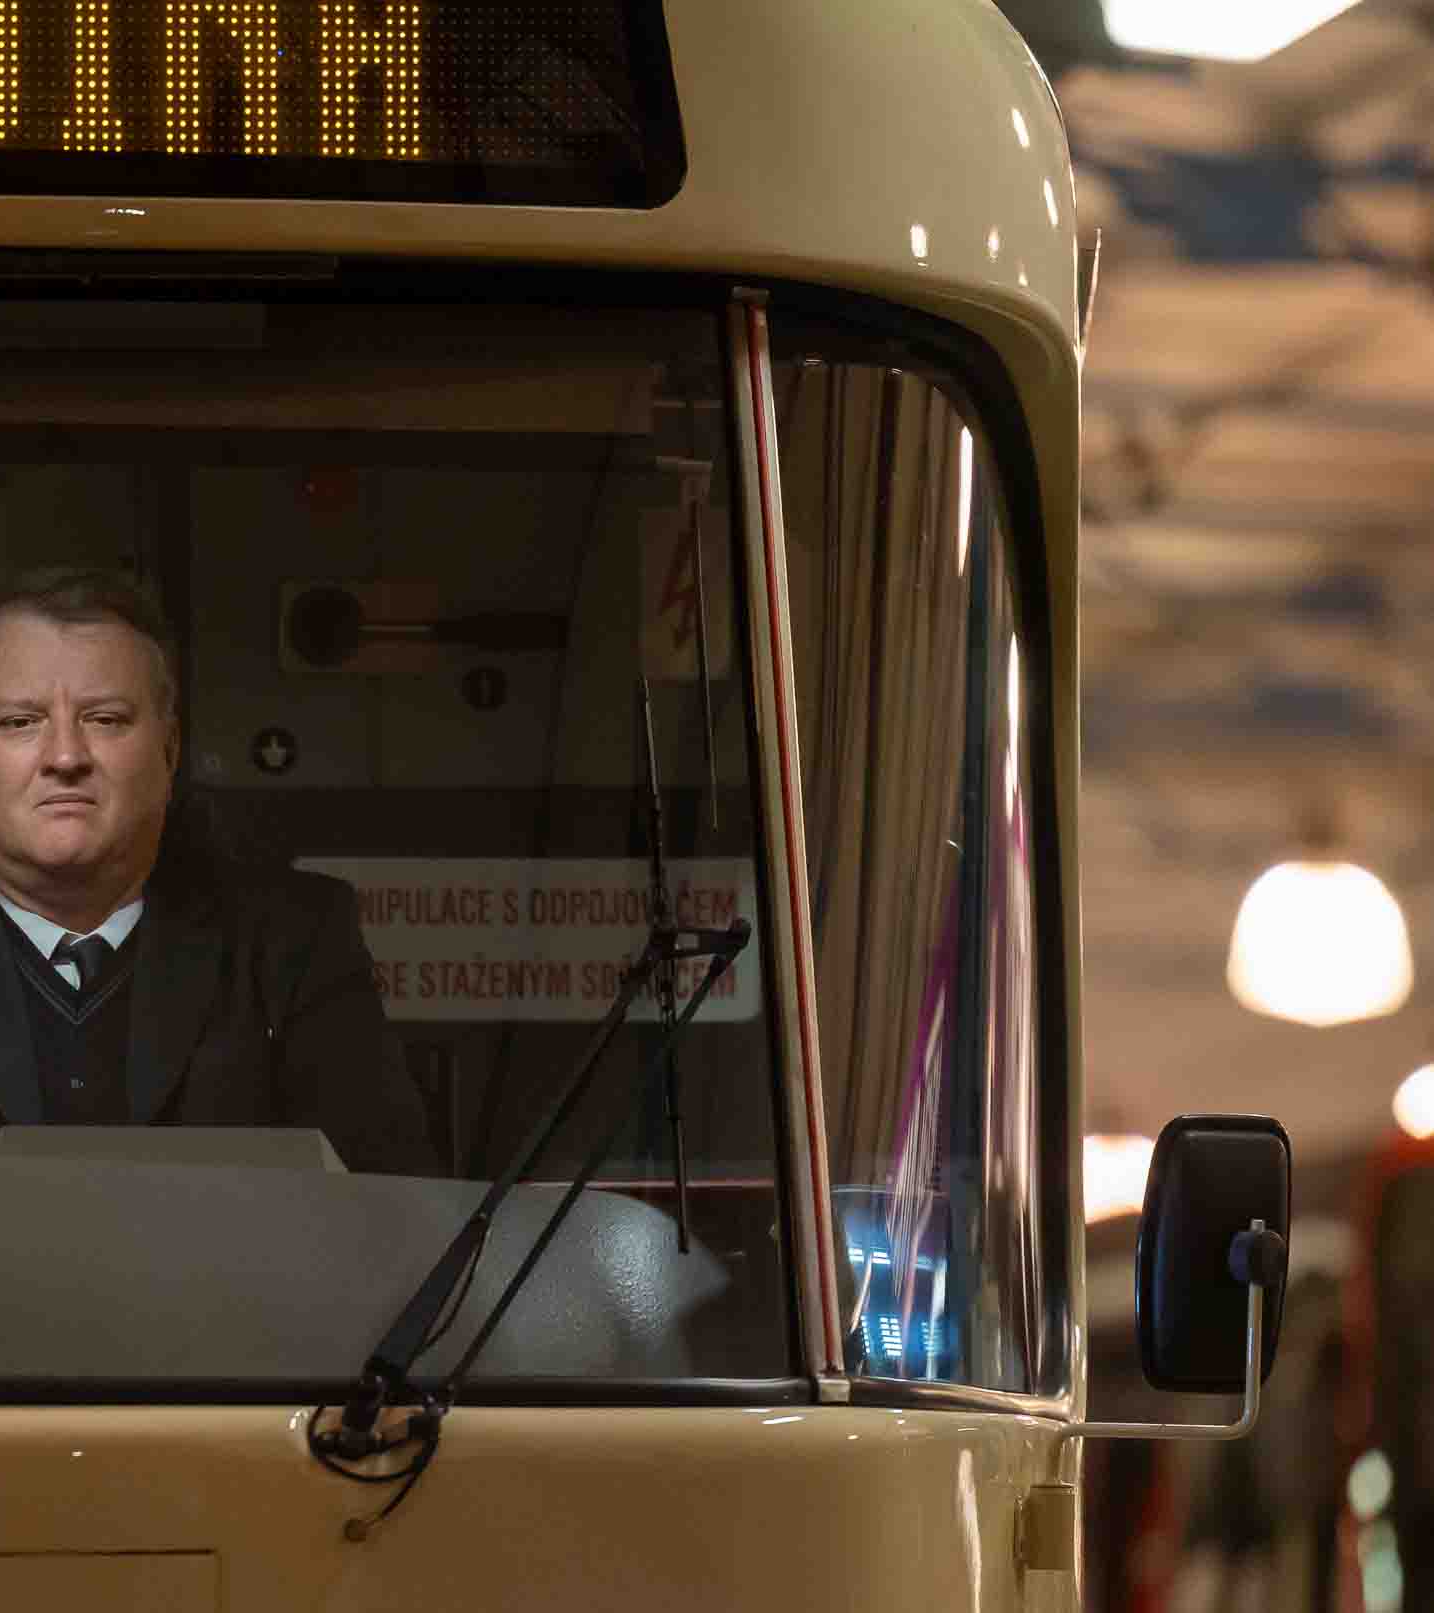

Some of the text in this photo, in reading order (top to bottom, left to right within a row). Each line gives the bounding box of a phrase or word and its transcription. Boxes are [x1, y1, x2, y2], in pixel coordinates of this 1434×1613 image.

[358, 882, 736, 927] NIPULACE S ODPOJOČEM
